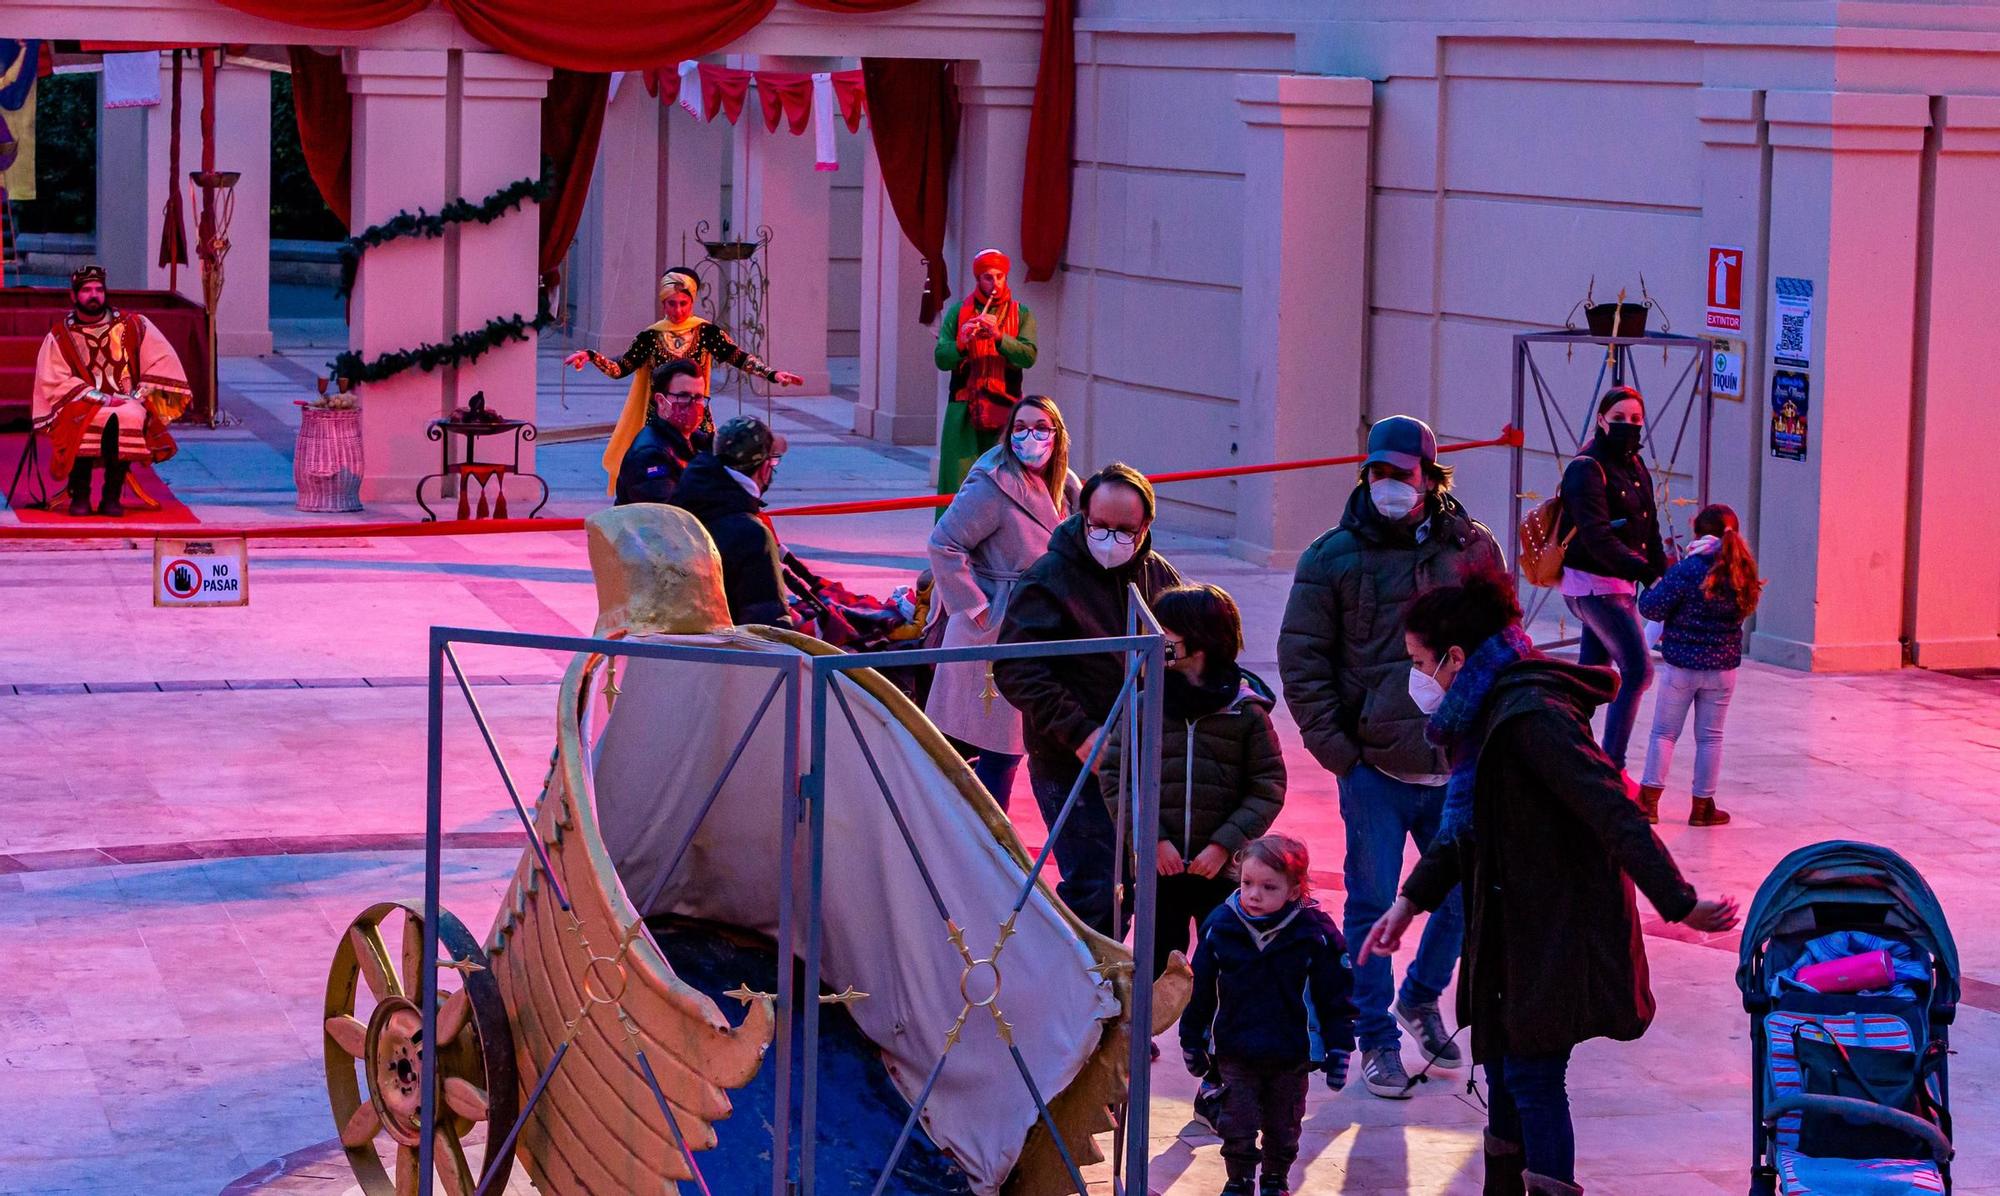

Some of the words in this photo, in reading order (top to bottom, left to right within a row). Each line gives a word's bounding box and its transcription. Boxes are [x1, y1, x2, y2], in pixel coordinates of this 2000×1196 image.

[1707, 314, 1740, 327] EXTINTOR
[1713, 372, 1737, 391] TIQUÍN
[212, 565, 228, 577] NO
[203, 579, 238, 591] PASAR
